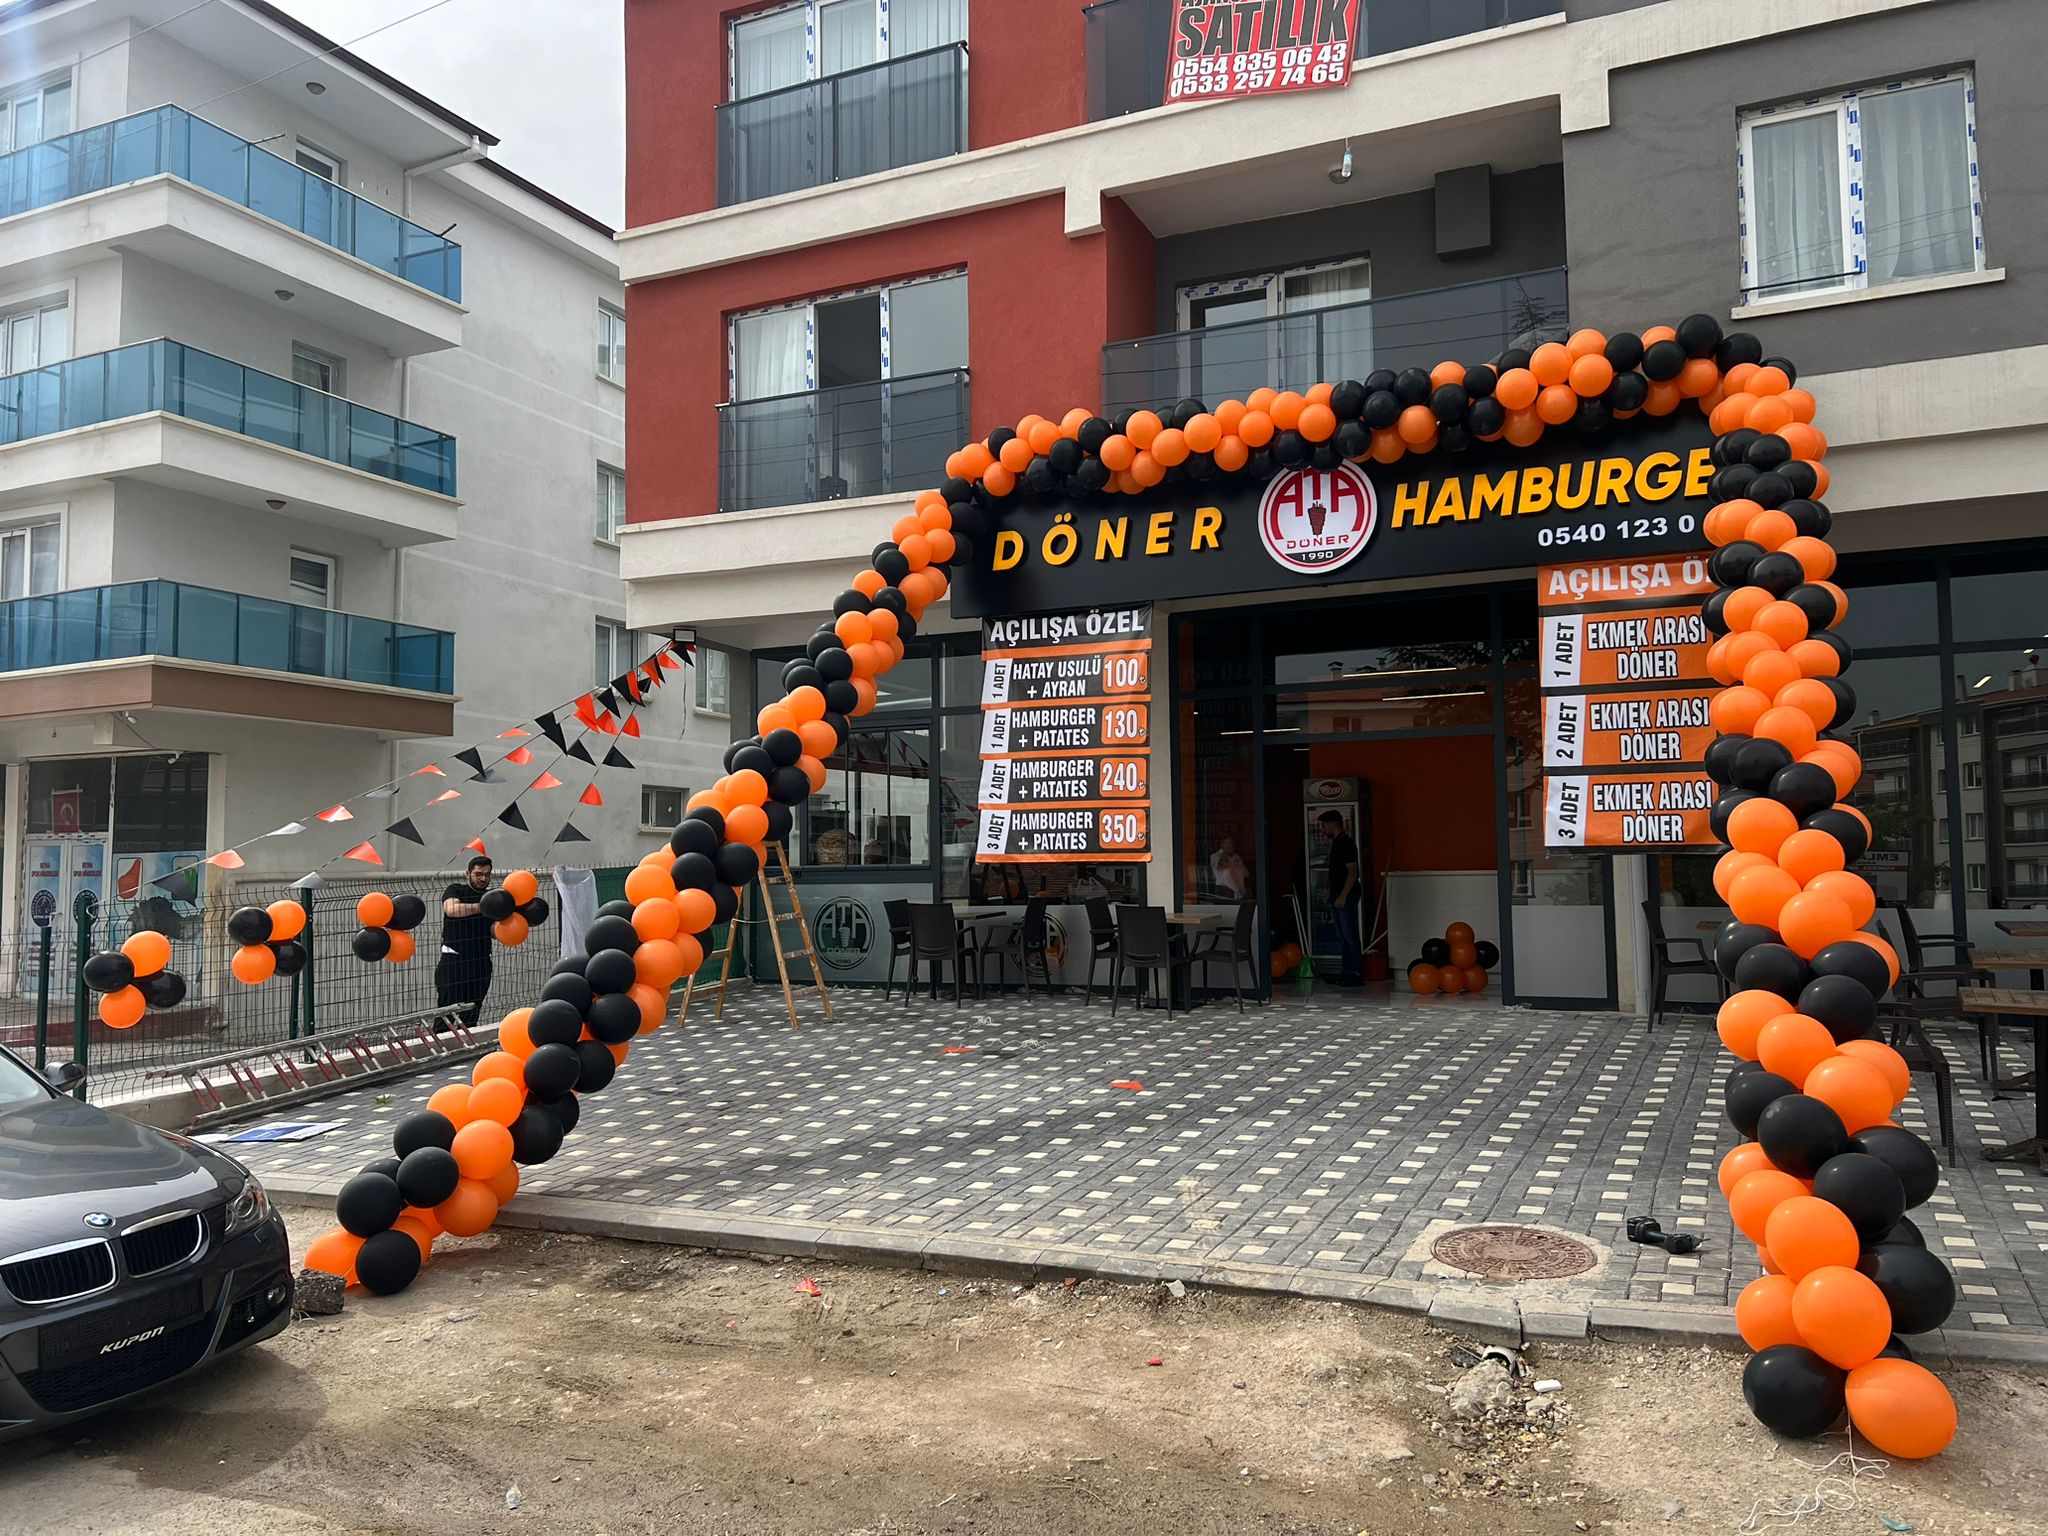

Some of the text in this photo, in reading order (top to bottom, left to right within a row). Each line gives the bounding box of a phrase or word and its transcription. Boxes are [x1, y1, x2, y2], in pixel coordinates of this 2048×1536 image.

[1176, 0, 1348, 58] SATILIK
[1173, 43, 1347, 79] 0554 835 06 43
[1170, 62, 1344, 97] 0533 257 74 65
[1270, 467, 1365, 540] ATA
[992, 506, 1222, 571] DÖNER
[1537, 514, 1695, 547] 0540 123 0
[1301, 550, 1334, 561] 1990
[1548, 556, 1712, 600] AÇILIŞA Ö
[990, 609, 1144, 647] AÇILIŞA ÖZEL
[1587, 615, 1707, 650] EKMEK ARASI
[1554, 622, 1575, 678] 1 ADET
[1617, 646, 1678, 680] DÖNER
[993, 663, 1006, 690] ADET
[1012, 655, 1101, 680] HATAY USULÜ
[1027, 680, 1086, 698] + AYRAN
[992, 713, 1006, 739] ADET
[1012, 708, 1096, 728] HAMBURGER
[1556, 702, 1577, 759] 2 ADET
[1590, 698, 1709, 730] EKMEK ARASI
[1018, 729, 1089, 747] + PATATES
[1620, 728, 1681, 761] DÖNER
[989, 763, 1006, 800] 2 ADET
[1012, 759, 1094, 779] HAMBURGER
[1018, 780, 1088, 798] + PATATES
[1593, 781, 1711, 811] EKMEK ARASI
[1012, 811, 1093, 831] HAMBURGER
[1558, 782, 1580, 838] 3 ADET
[1622, 810, 1684, 842] DÖNER
[987, 813, 1005, 849] 3 ADET
[1018, 832, 1088, 850] + PATATES
[818, 902, 871, 949] ATA
[100, 1325, 165, 1354] KUPON
